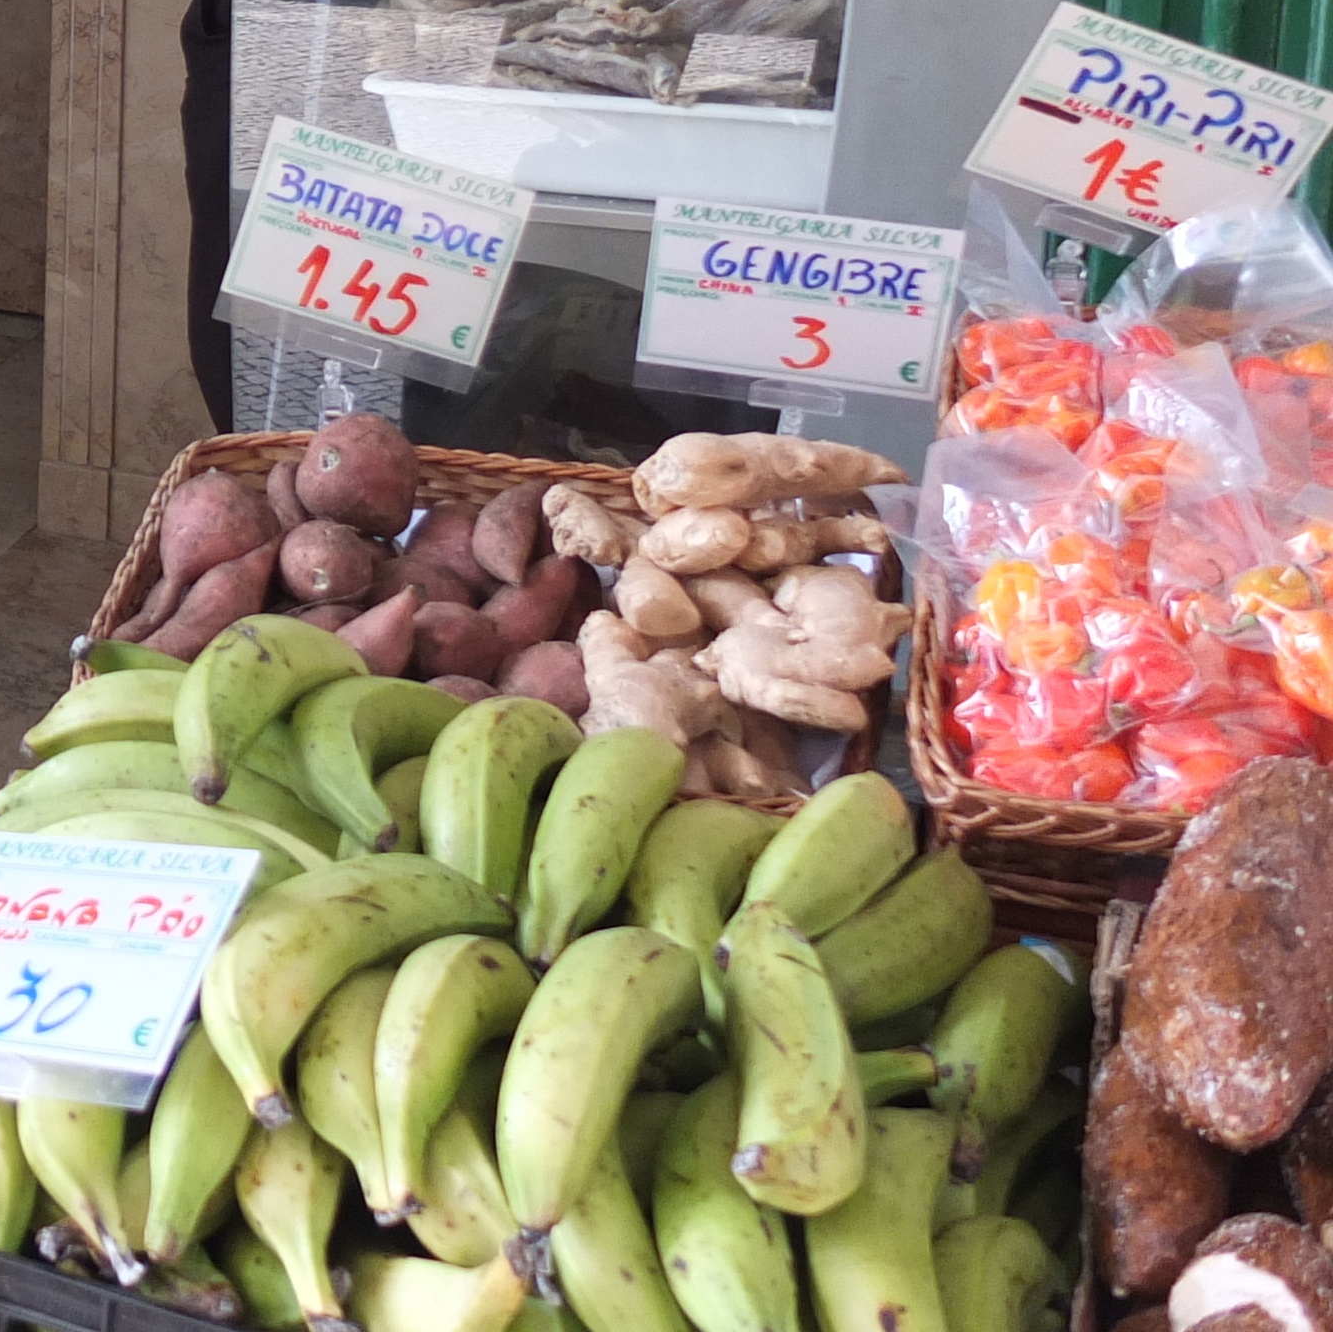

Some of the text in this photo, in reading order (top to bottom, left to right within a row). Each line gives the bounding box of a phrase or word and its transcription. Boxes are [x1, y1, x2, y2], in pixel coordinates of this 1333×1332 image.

[1073, 14, 1327, 111] MANTEIGARIA SILVA
[1069, 48, 1296, 166] PIRI-PIRI
[289, 125, 517, 208] MANTEIGARIA SILVA
[1084, 138, 1165, 207] 1€
[265, 162, 505, 264] BATATA DOCE
[672, 203, 854, 239] MANTEIGARIA
[862, 225, 943, 250] SILVA
[294, 243, 473, 350] 1.45 €
[702, 239, 928, 302] GENGIBRE
[780, 315, 921, 383] 3 €
[150, 850, 236, 874] SILVA
[131, 1017, 161, 1047] €
